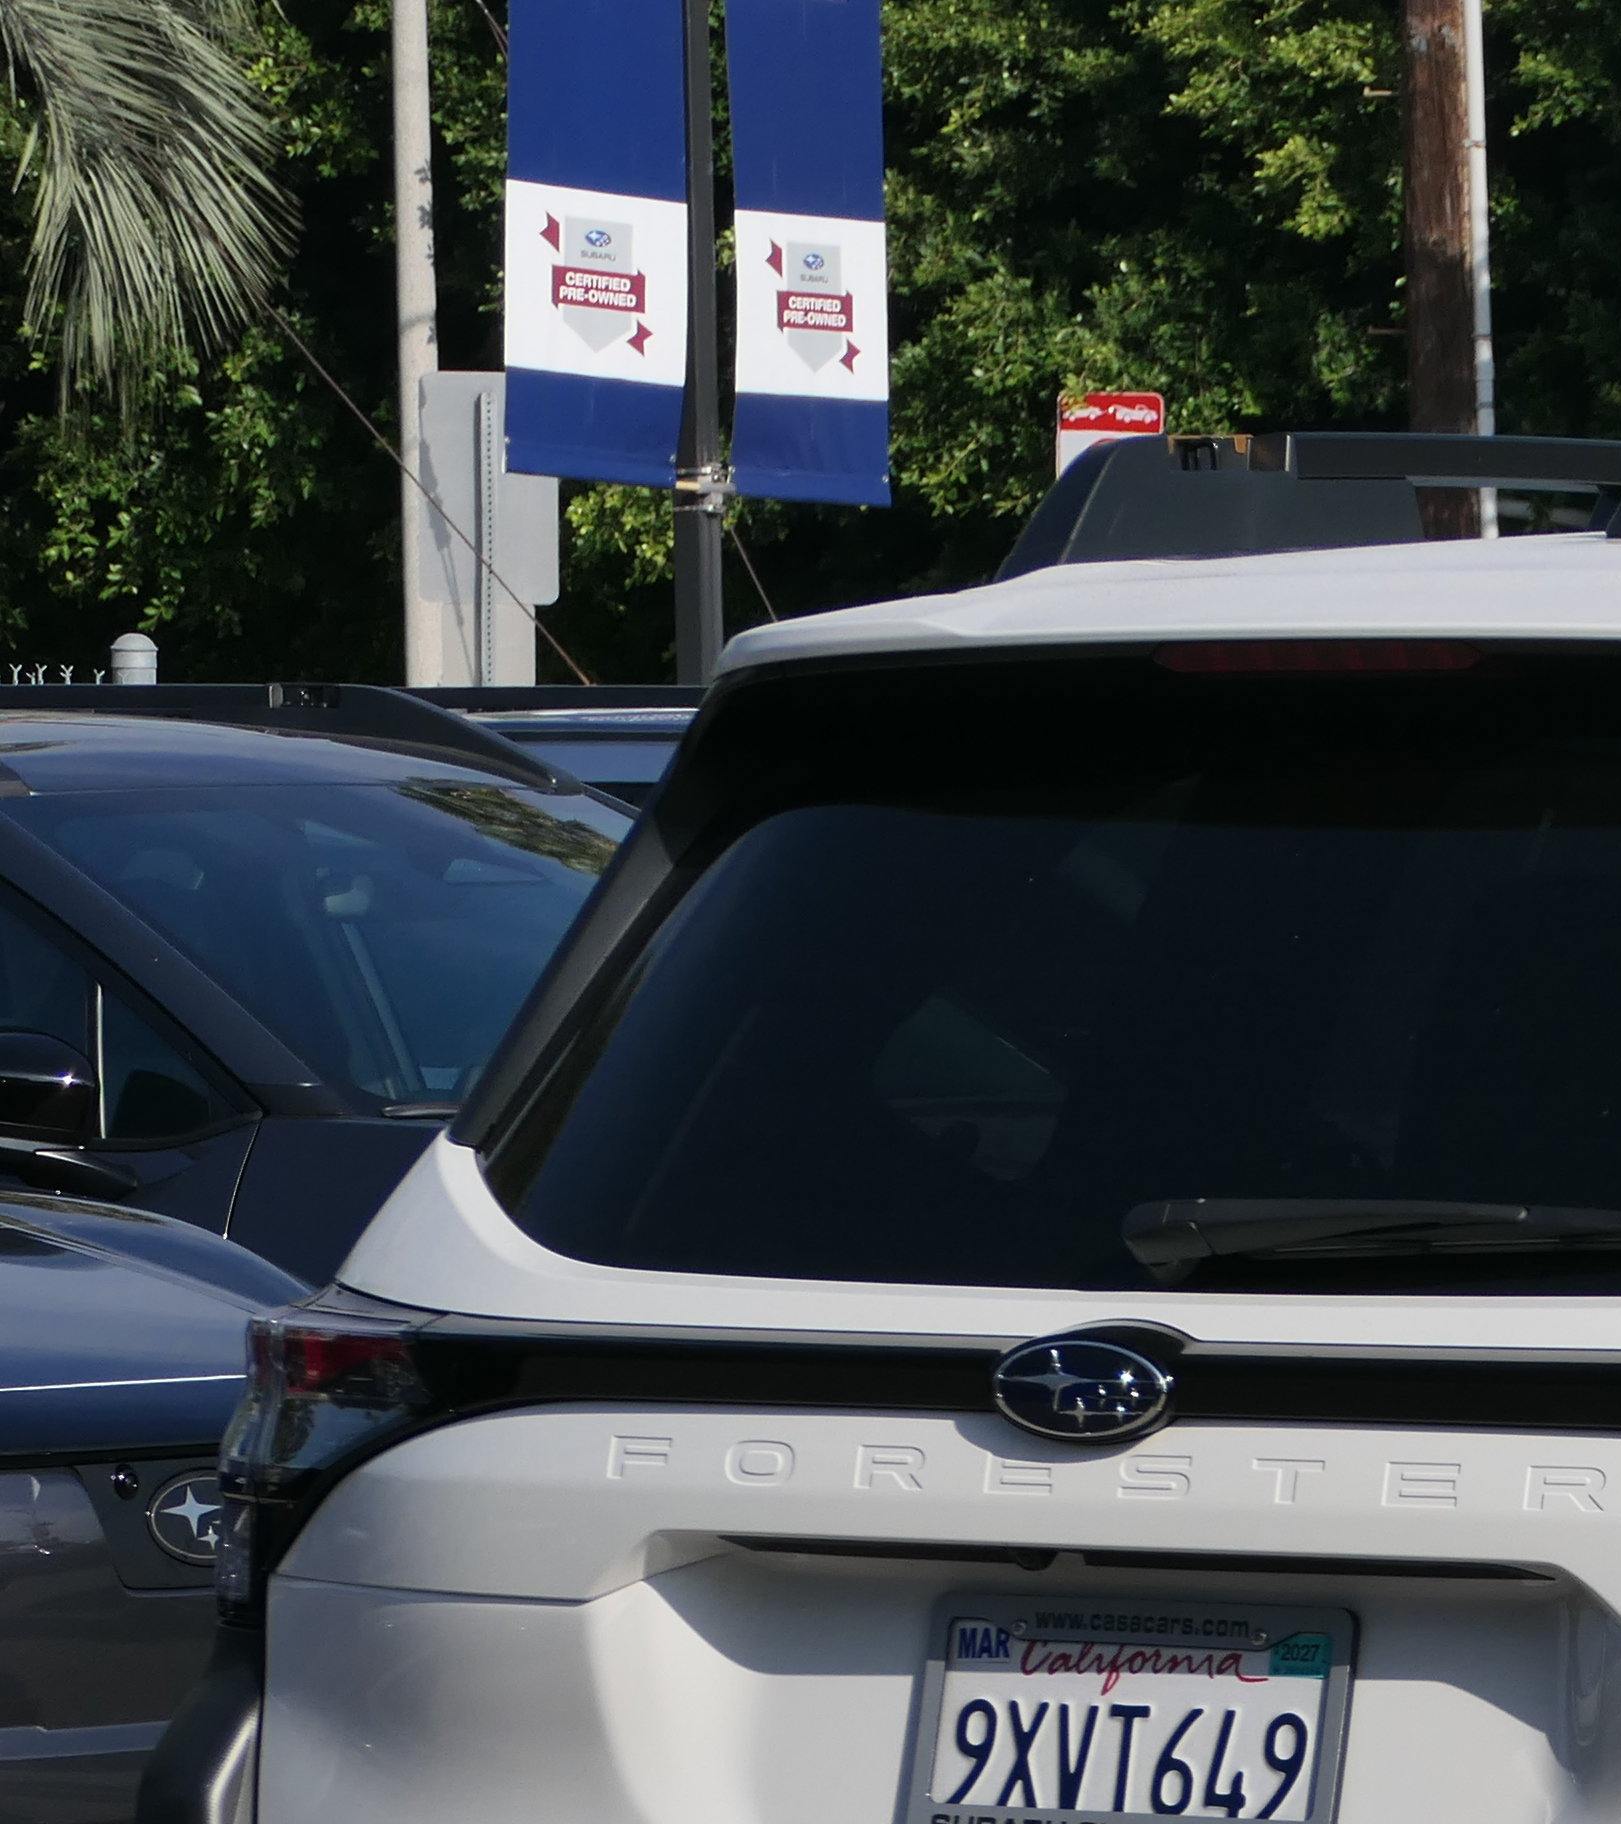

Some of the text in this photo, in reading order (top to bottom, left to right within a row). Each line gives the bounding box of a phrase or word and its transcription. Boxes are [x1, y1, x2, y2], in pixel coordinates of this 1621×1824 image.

[580, 248, 617, 262] SUBARU
[565, 271, 631, 292] CERTIFIED
[558, 286, 637, 309] PRE-OWNED
[787, 296, 841, 313] CERTIFIED
[782, 310, 846, 328] PRE-OWNED
[605, 1433, 1609, 1513] FORESTER
[1035, 1611, 1250, 1640] www.casacars.com
[957, 1626, 1011, 1661] MAR
[1280, 1643, 1321, 1663] 2027
[1019, 1640, 1270, 1697] California
[945, 1698, 1308, 1820] 9XVT649
